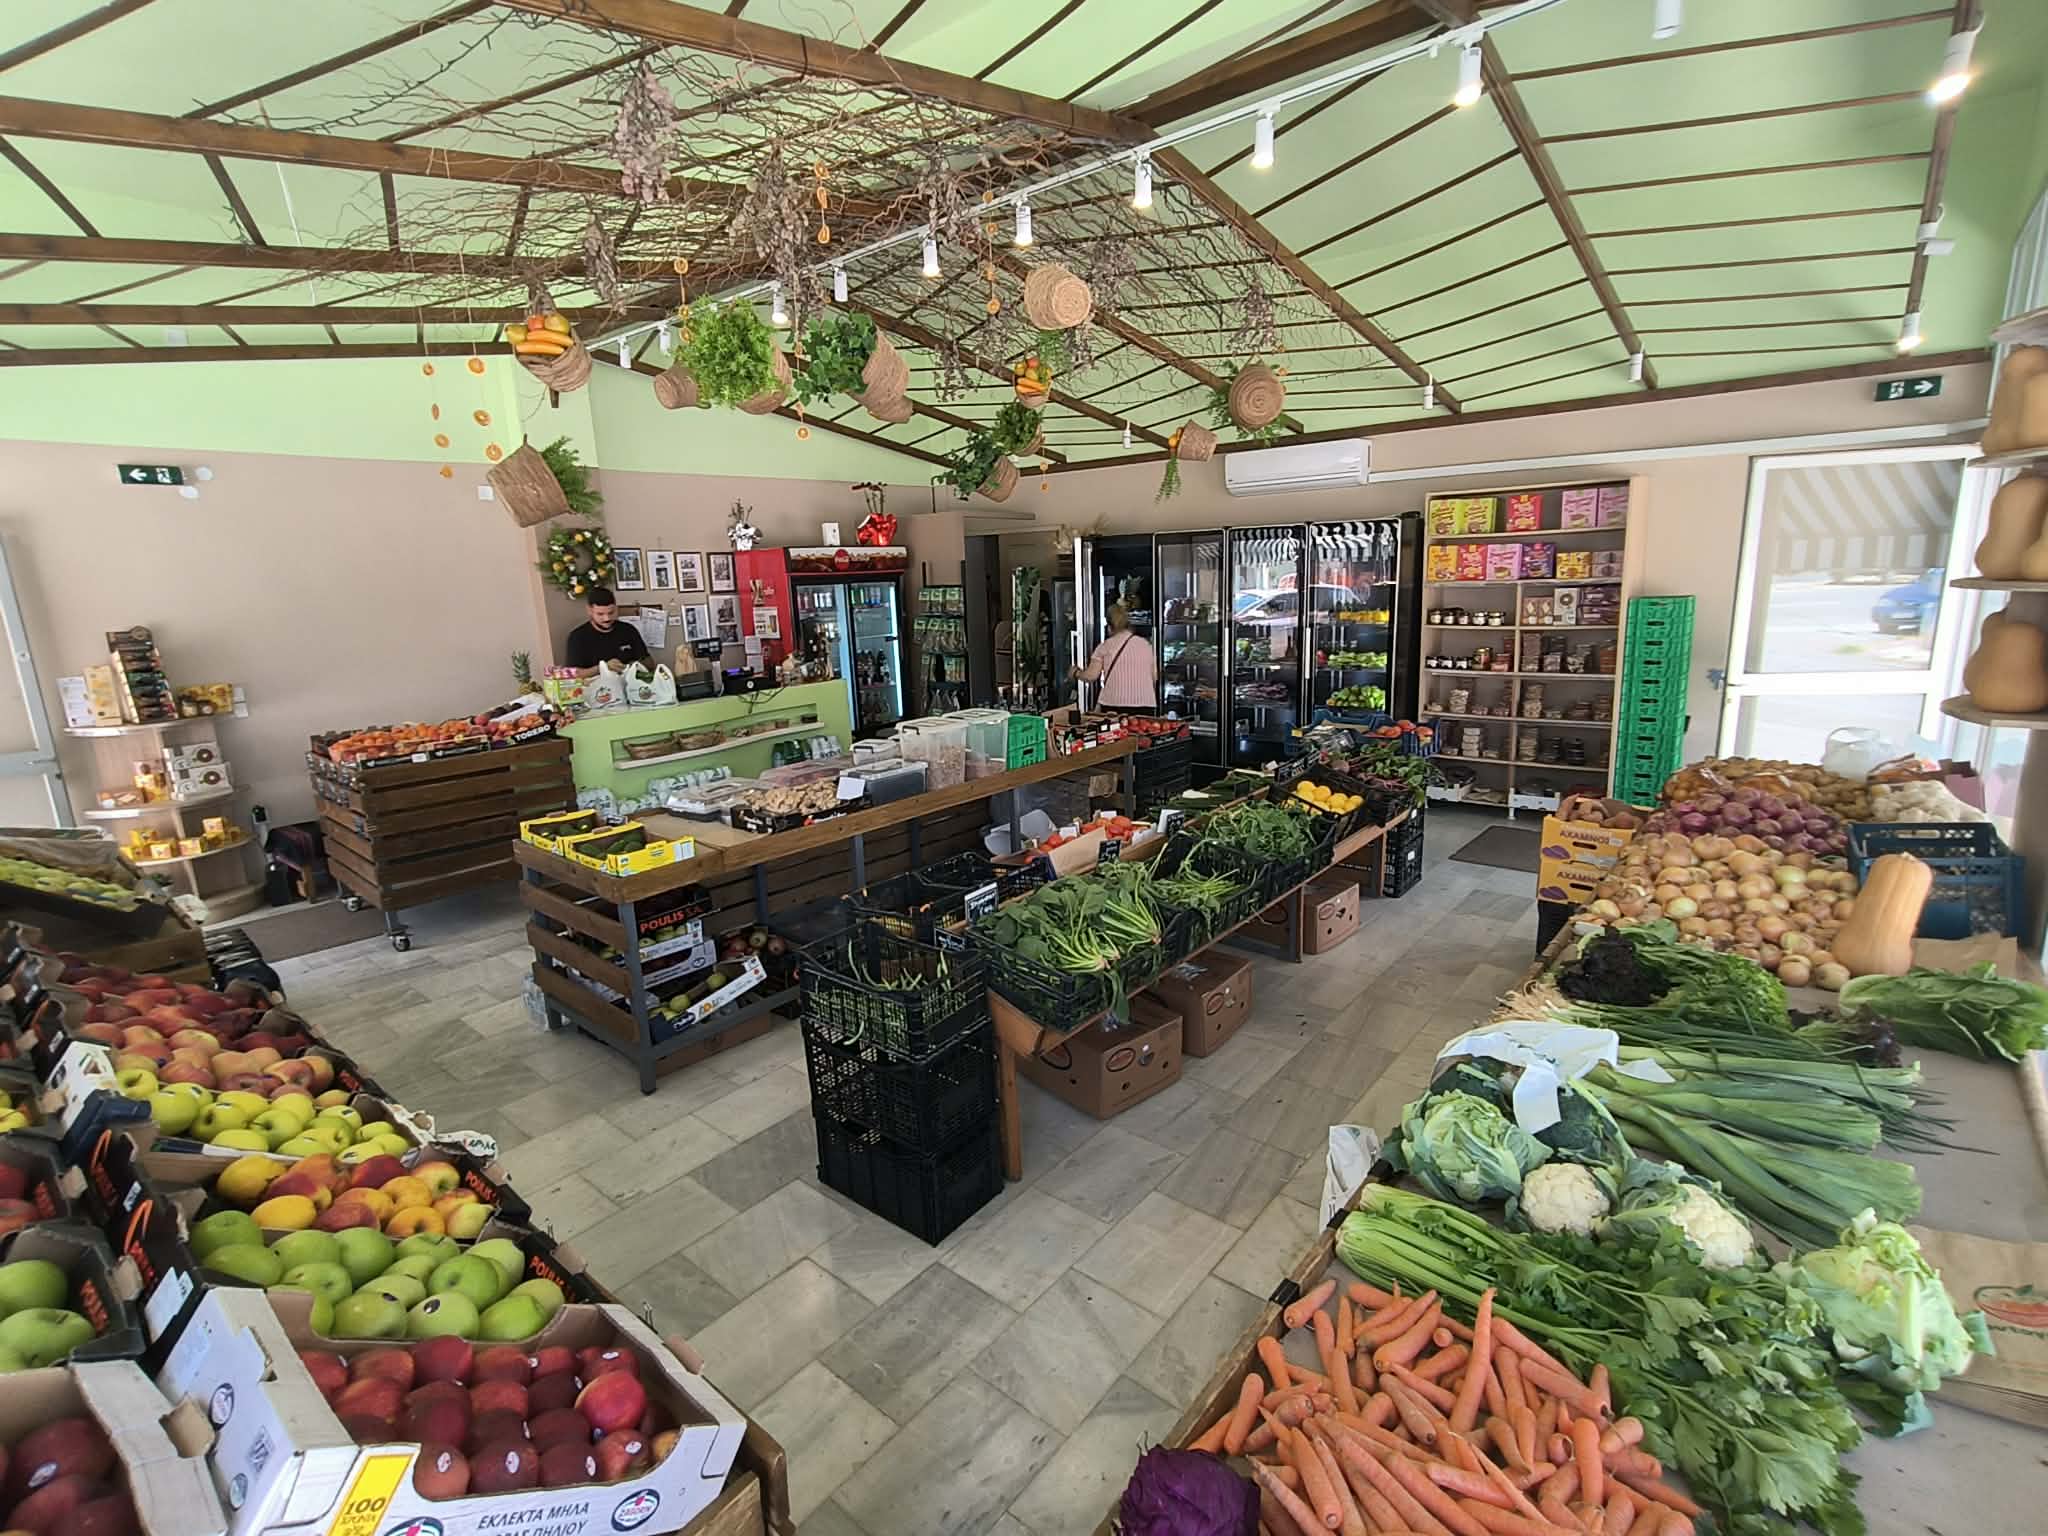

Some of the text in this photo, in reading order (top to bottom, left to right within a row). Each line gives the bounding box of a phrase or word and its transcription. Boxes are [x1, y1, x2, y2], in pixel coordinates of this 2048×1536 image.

[515, 723, 551, 741] TORERO
[640, 911, 685, 934] POULIS
[344, 1497, 386, 1516] 100
[477, 1502, 590, 1530] ΕΚΛΕΚΤΑ ΜΗΛΑ
